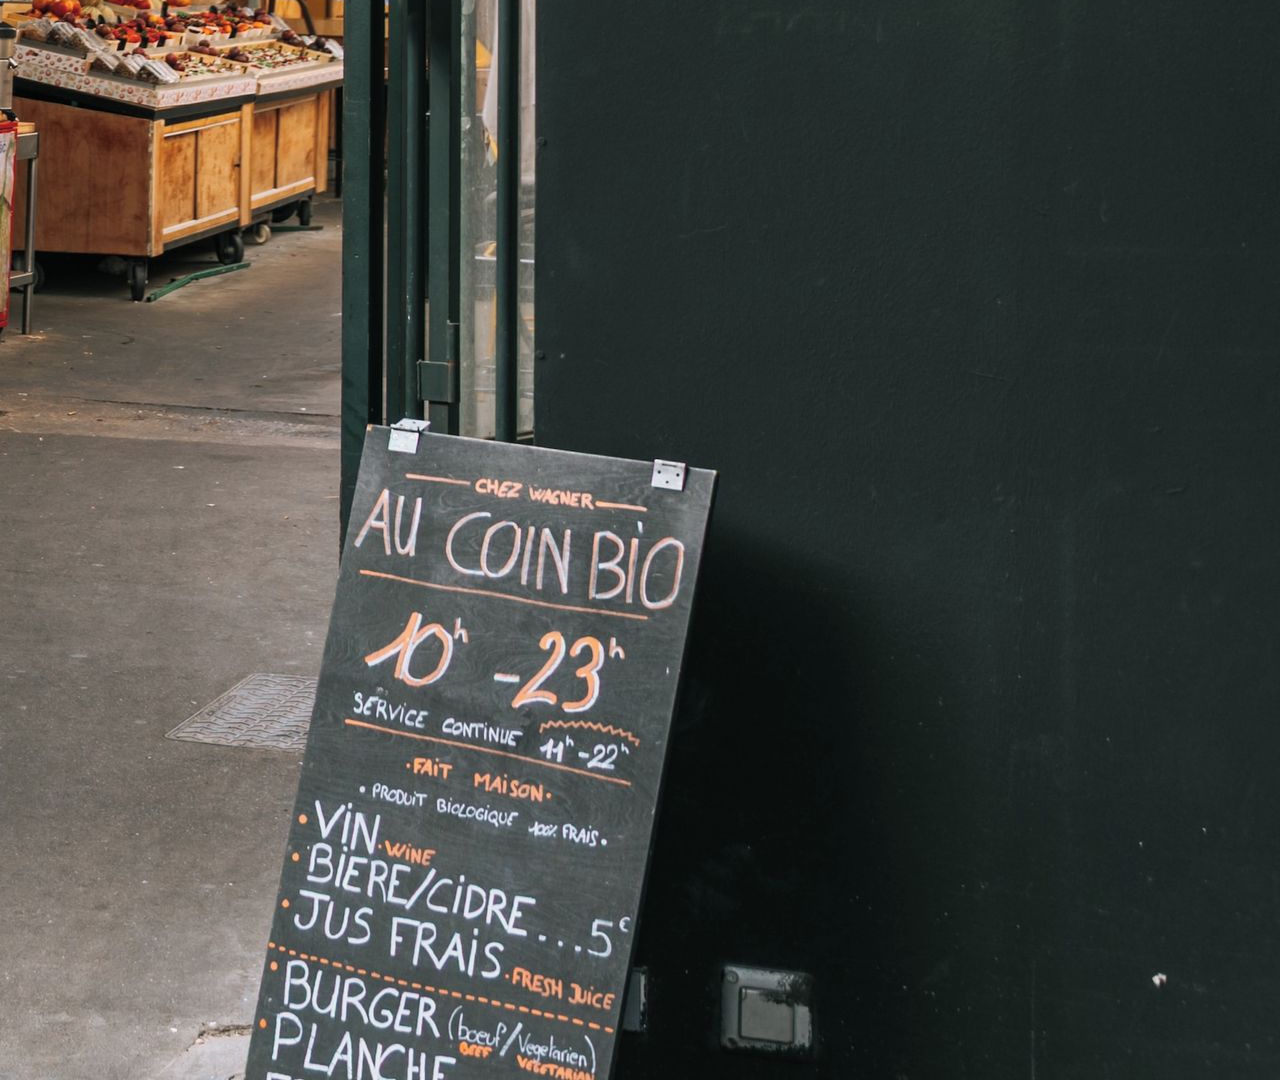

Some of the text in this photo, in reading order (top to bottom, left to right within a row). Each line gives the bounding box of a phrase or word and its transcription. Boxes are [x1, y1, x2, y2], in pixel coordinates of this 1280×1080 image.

[475, 478, 596, 510] CHEZ WAGNER
[355, 488, 685, 610] AU COIN BIO
[352, 690, 429, 729] SERVICE
[441, 717, 524, 748] CONTINUE
[413, 756, 544, 802] FAIT MAISON
[314, 800, 437, 867] VIN WINE
[371, 782, 600, 847] PRODUIT BIOLOGIQUE 100% FRAIS
[293, 888, 617, 1011] JUS FRAIS FRESH JUICE
[283, 959, 441, 1039] BURGER
[271, 1011, 457, 1080] PLANCHE
[458, 1040, 493, 1059] BEEF
